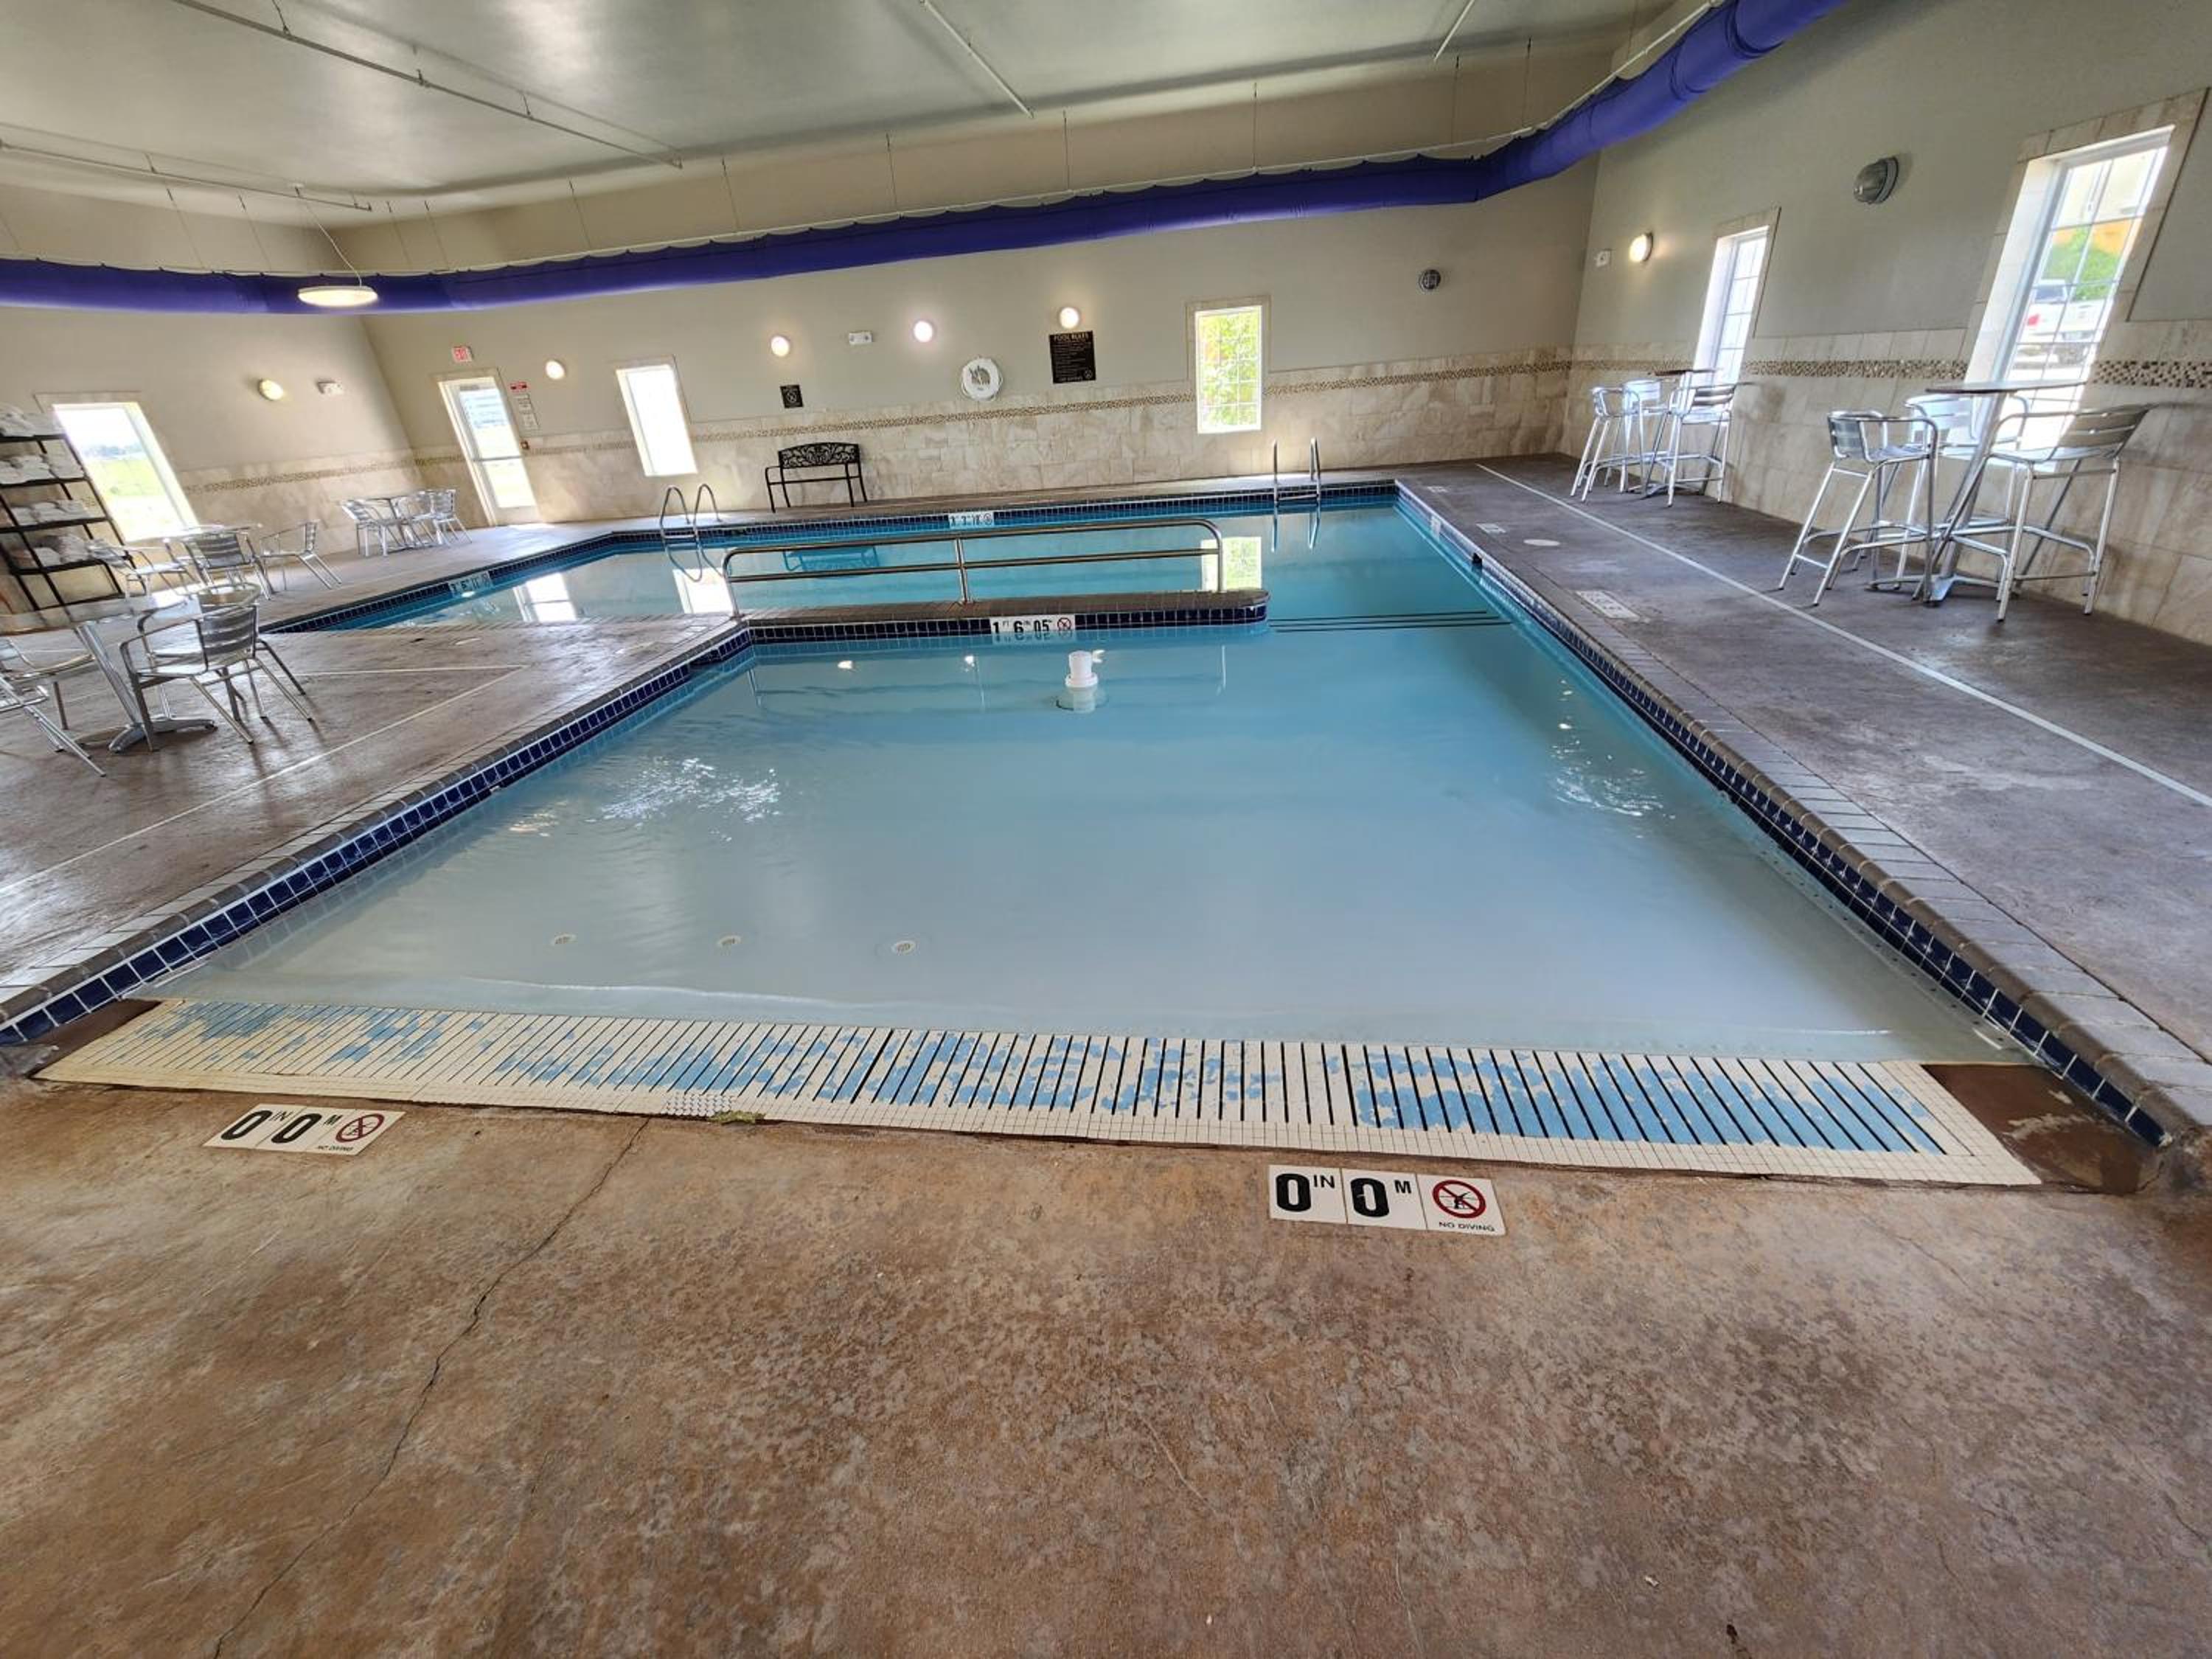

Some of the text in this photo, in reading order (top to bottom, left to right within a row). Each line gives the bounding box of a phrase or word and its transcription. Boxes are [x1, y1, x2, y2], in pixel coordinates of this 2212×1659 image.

[992, 622, 999, 633] 1
[1014, 621, 1023, 633] 6
[220, 1110, 344, 1144] 0 IN 0 M
[1275, 1173, 1412, 1217] 0 IN 0 M
[1458, 1223, 1495, 1232] DIVING
